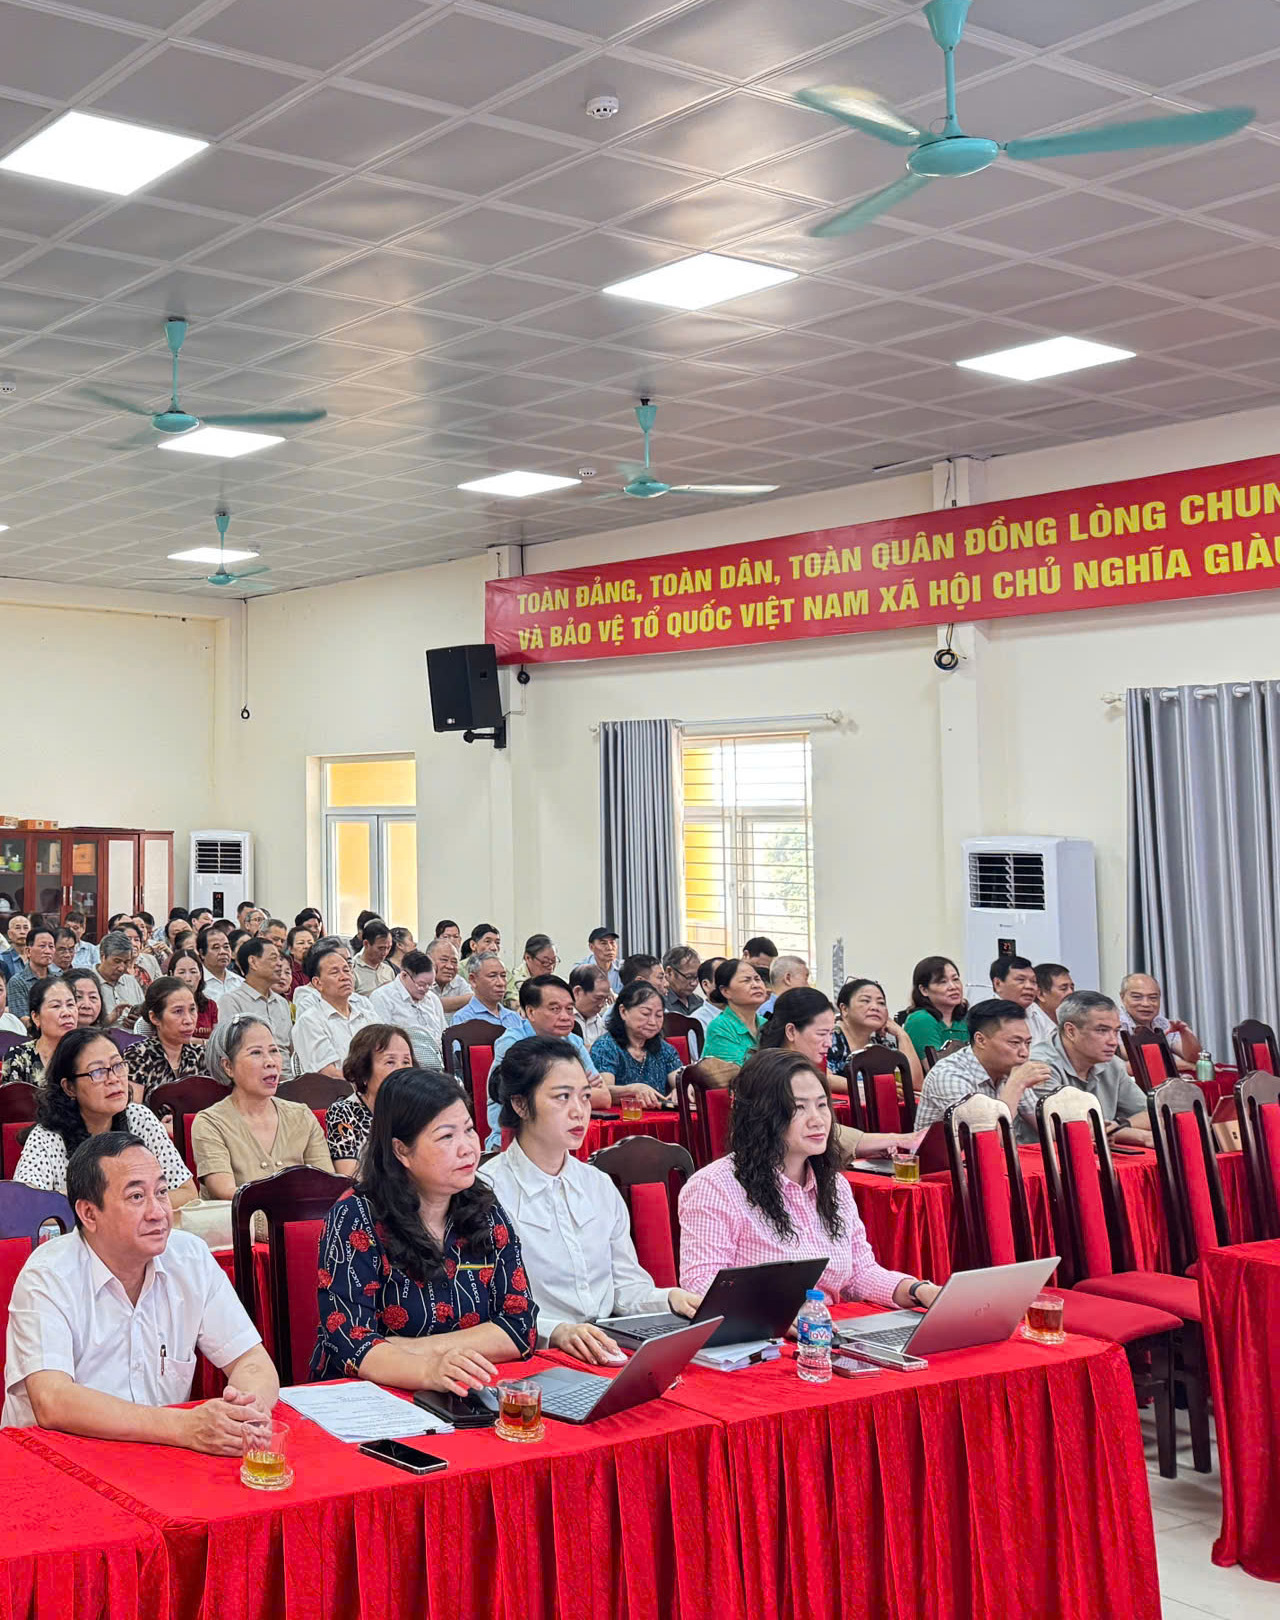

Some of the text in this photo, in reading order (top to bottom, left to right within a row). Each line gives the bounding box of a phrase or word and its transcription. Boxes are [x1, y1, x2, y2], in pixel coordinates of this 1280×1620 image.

[517, 586, 569, 615] TOÀN
[576, 575, 642, 608] ĐẢNG,
[649, 566, 712, 598] TOÀN
[720, 557, 781, 589] DÂN,
[789, 545, 862, 580] TOÀN
[872, 531, 954, 571] QUÂN
[964, 515, 1057, 557] ĐỒNG
[1070, 503, 1166, 542] LÒNG
[518, 532, 1280, 651] VÀ BẢO VỆ TỔ QUỐC VIỆT NAM XÃ HỘI CHỦ NGHĨA GIÀ
